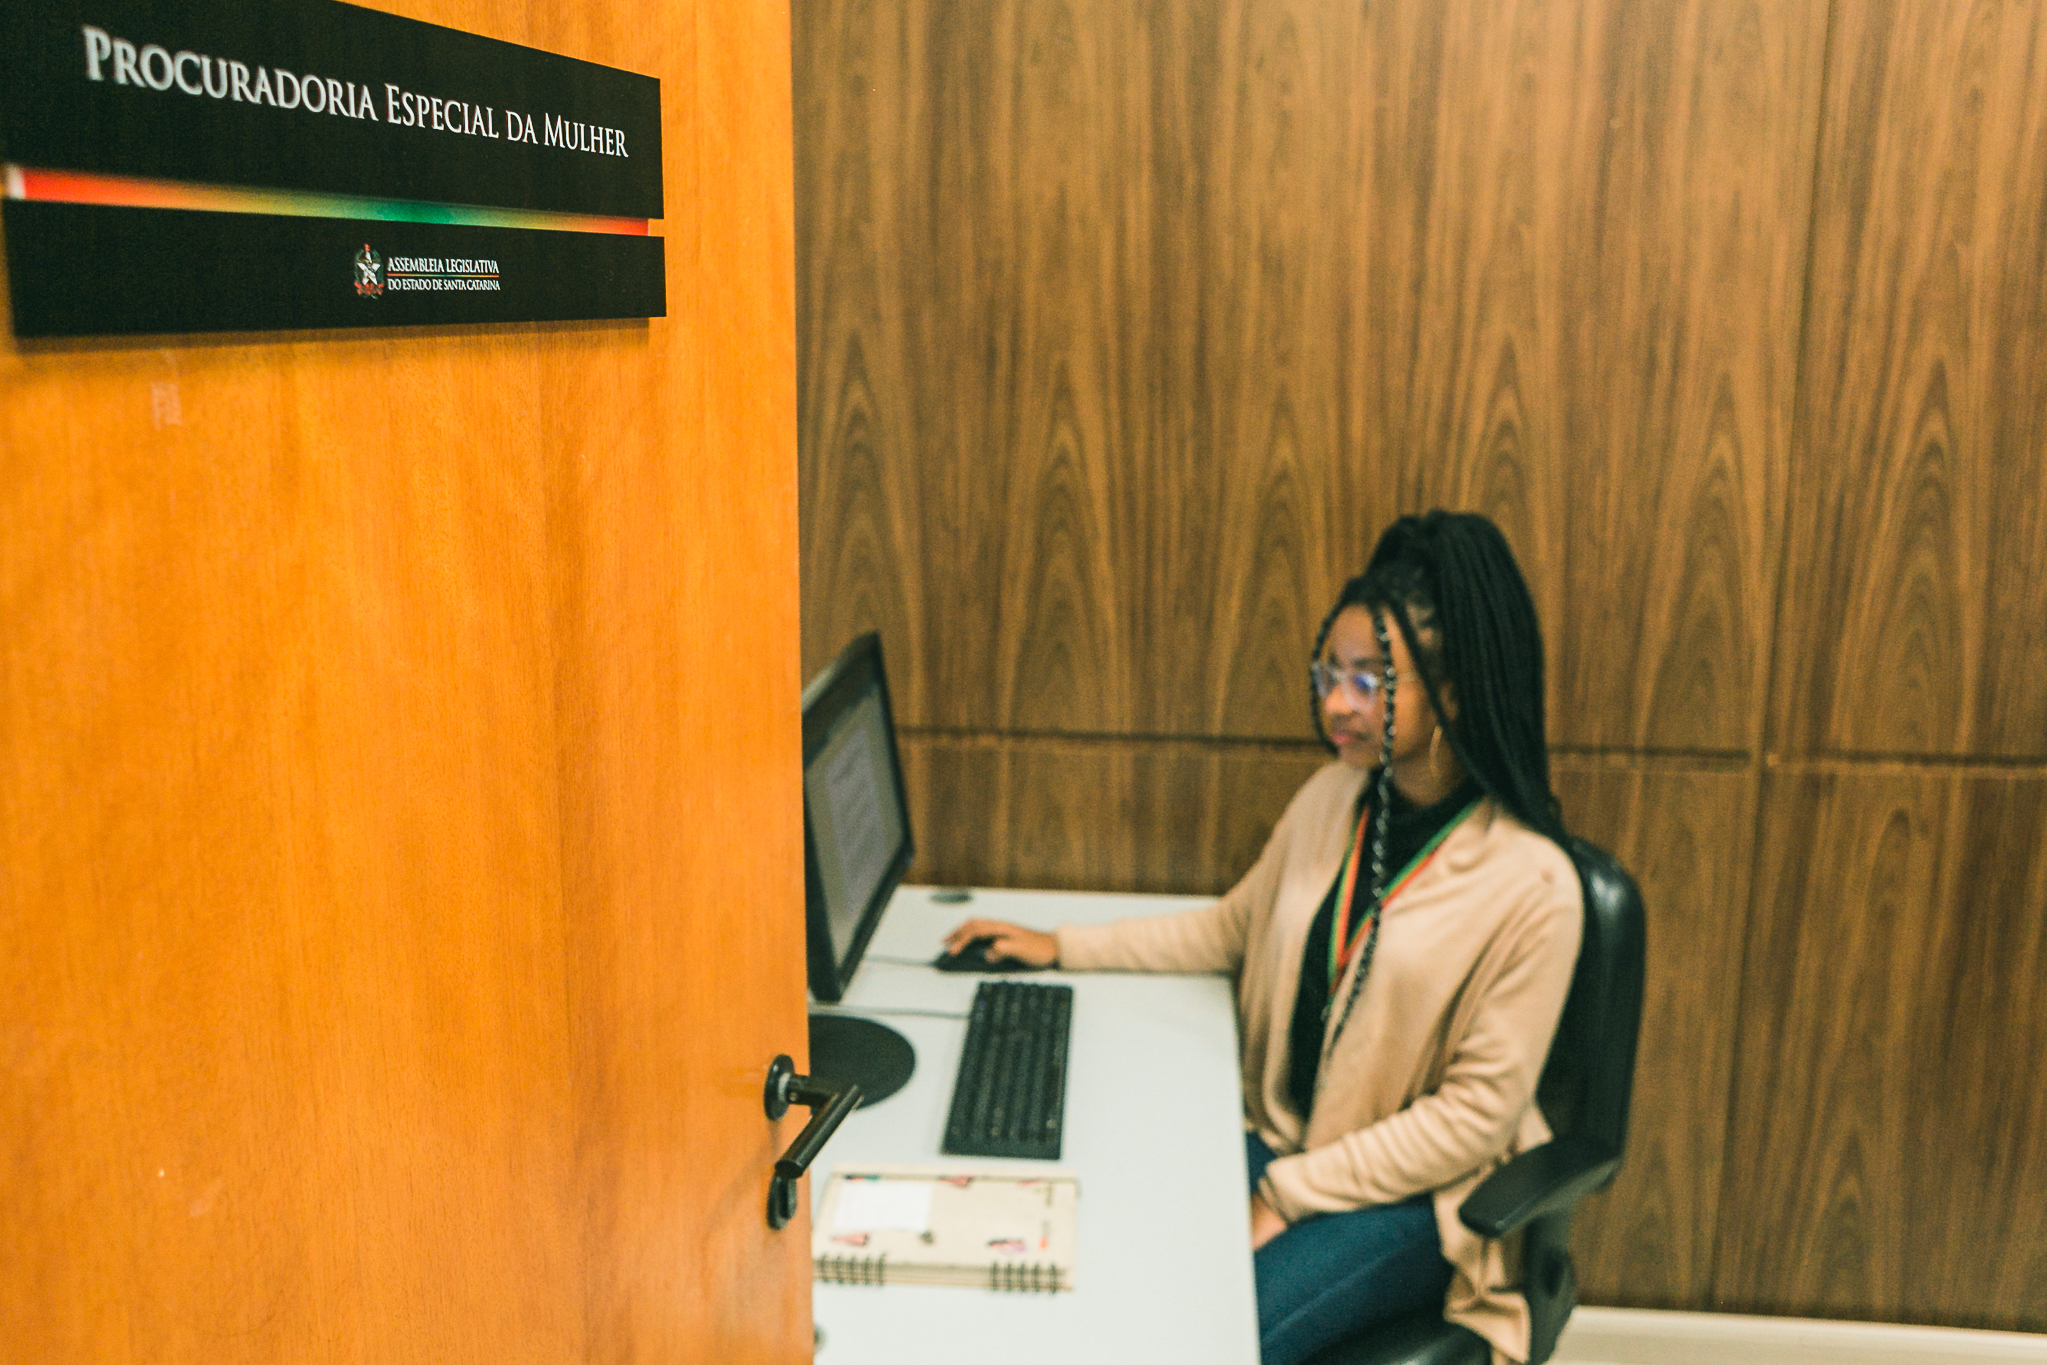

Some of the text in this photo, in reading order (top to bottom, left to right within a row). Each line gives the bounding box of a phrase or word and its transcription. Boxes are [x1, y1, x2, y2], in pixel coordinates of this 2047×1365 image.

[82, 24, 629, 158] PROCURADORIA ESPECIAL DA MULHER
[387, 257, 500, 273] ASSEMBLEIA LEGISLATIVA
[387, 278, 501, 290] DO ESTADO DE SANTA CATARINA
